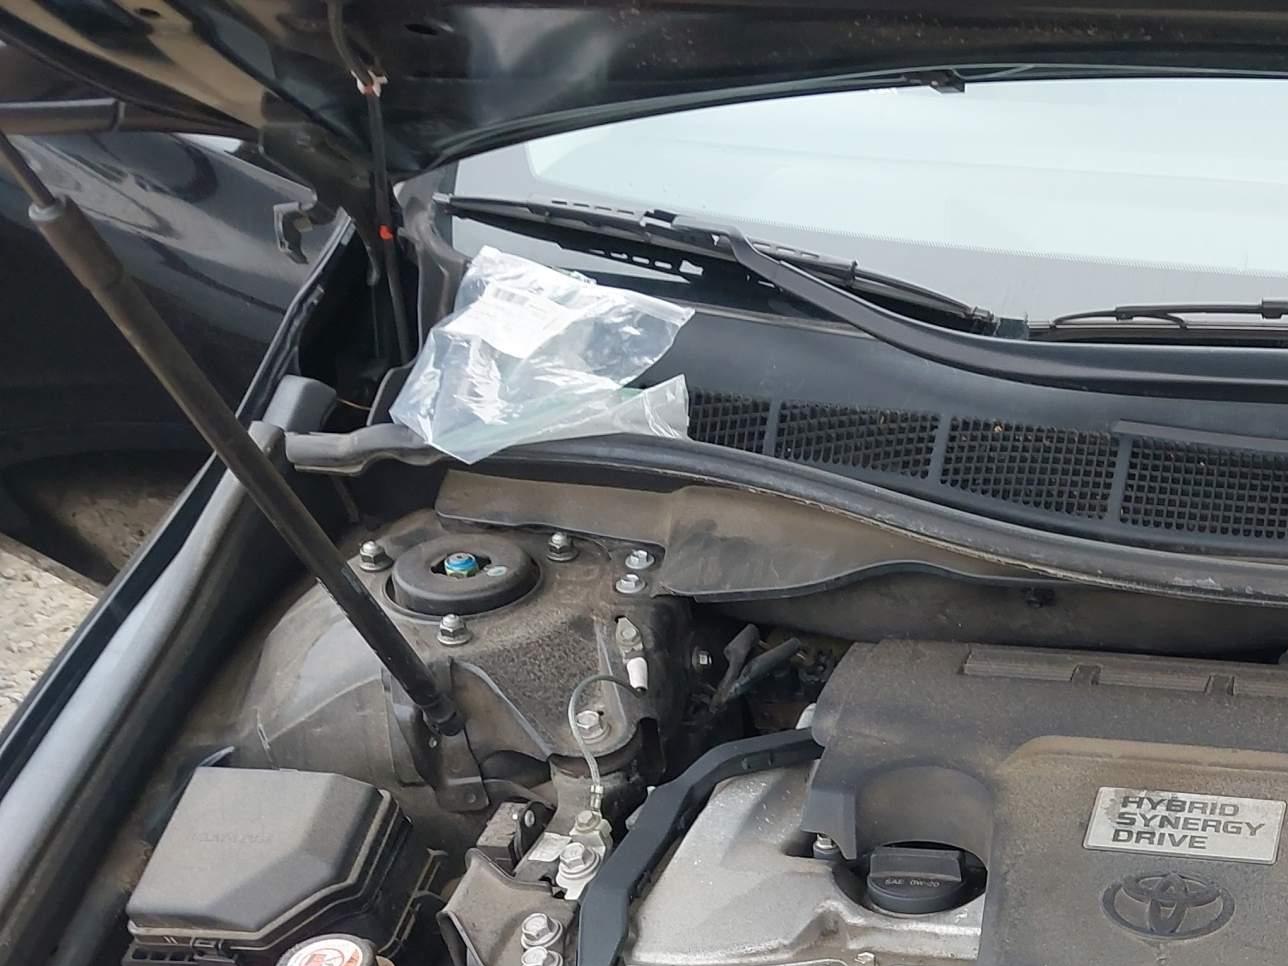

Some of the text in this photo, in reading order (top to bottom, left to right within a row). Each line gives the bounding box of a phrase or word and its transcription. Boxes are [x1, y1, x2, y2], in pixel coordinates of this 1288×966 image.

[1120, 796, 1239, 817] HYBRID
[1116, 811, 1265, 837] SYNERGY
[1112, 829, 1208, 850] DRIVE
[909, 879, 940, 888] 0W-20
